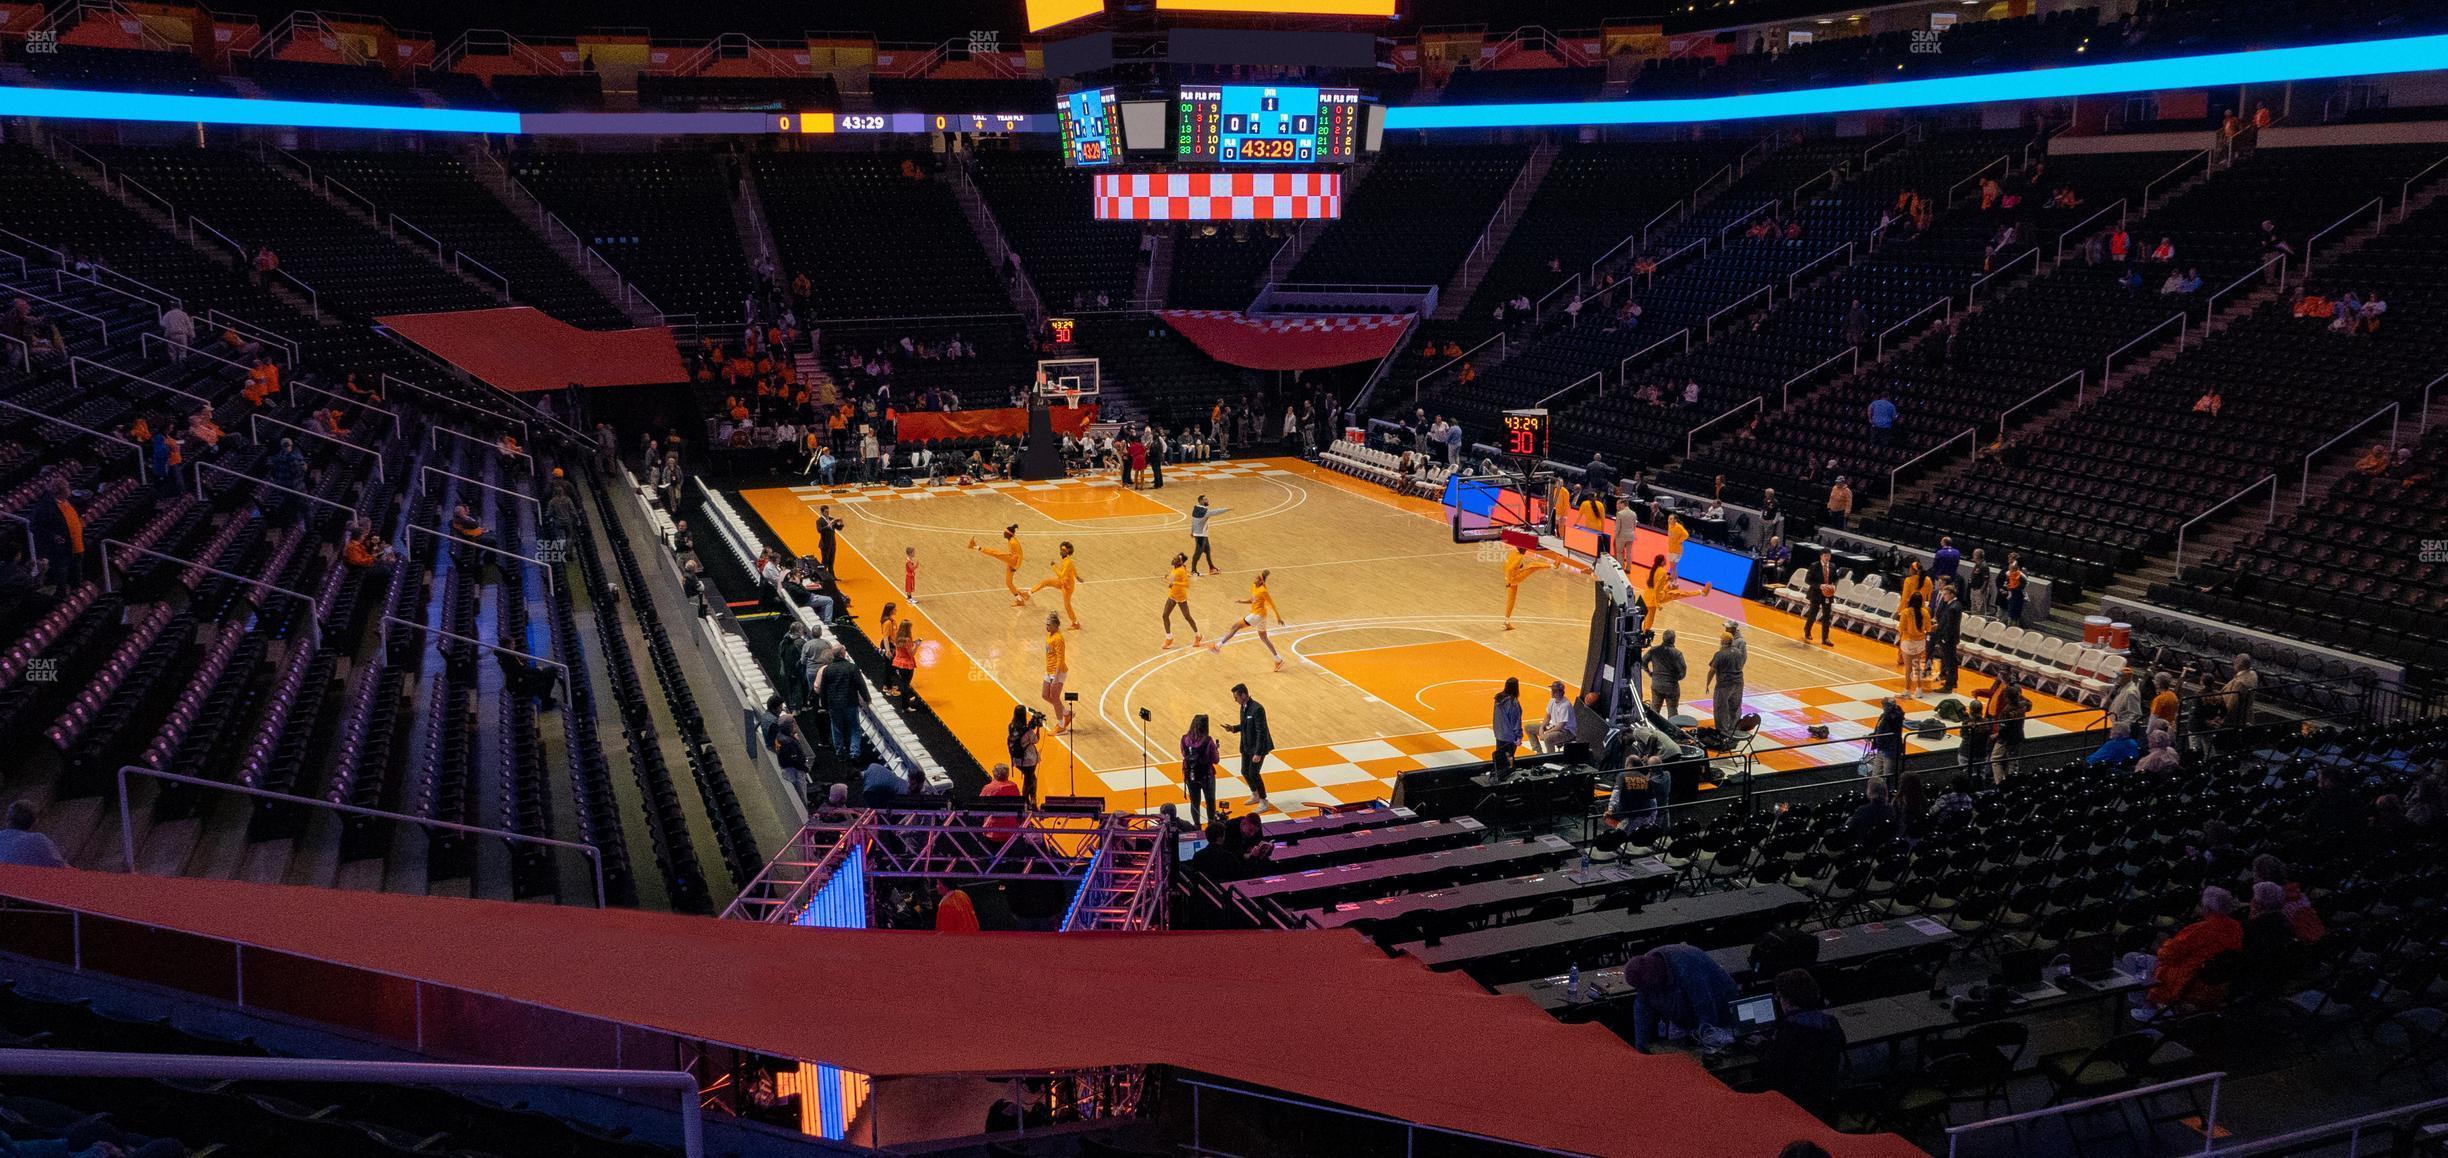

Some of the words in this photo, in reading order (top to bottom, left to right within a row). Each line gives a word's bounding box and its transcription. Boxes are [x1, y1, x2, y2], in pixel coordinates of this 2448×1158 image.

[1211, 103, 1218, 112] 9
[1267, 98, 1274, 111] 1
[1321, 106, 1328, 115] 3
[1336, 106, 1342, 114] 0
[1347, 106, 1354, 115] 0
[779, 116, 789, 130] 0
[842, 116, 884, 130] 43:29
[936, 116, 946, 130] 0
[1184, 114, 1189, 123] 1
[1208, 114, 1219, 123] 17
[1320, 117, 1329, 125] 11
[1335, 116, 1342, 124] 0
[1346, 116, 1353, 125] 7
[975, 120, 983, 130] 4
[1006, 121, 1014, 130] 0
[1231, 117, 1239, 131] 0
[1251, 123, 1259, 133] 4
[1280, 123, 1287, 133] 4
[1299, 118, 1307, 132] 0
[1210, 125, 1216, 134] 8
[1318, 127, 1329, 135] 20
[1346, 126, 1352, 135] 7
[1207, 135, 1219, 144] 10
[1317, 136, 1327, 145] 21
[1345, 136, 1352, 145] 2
[1195, 145, 1202, 154] 0
[1209, 145, 1216, 154] 0
[1226, 148, 1233, 158] 0
[1241, 140, 1294, 158] 43:29
[1300, 149, 1307, 159] 0
[1333, 146, 1340, 155] 0
[1344, 146, 1351, 155] 0
[1052, 321, 1073, 329] 43:29
[1056, 329, 1070, 343] 30
[1504, 416, 1538, 430] 43:29
[1510, 430, 1533, 454] 30
